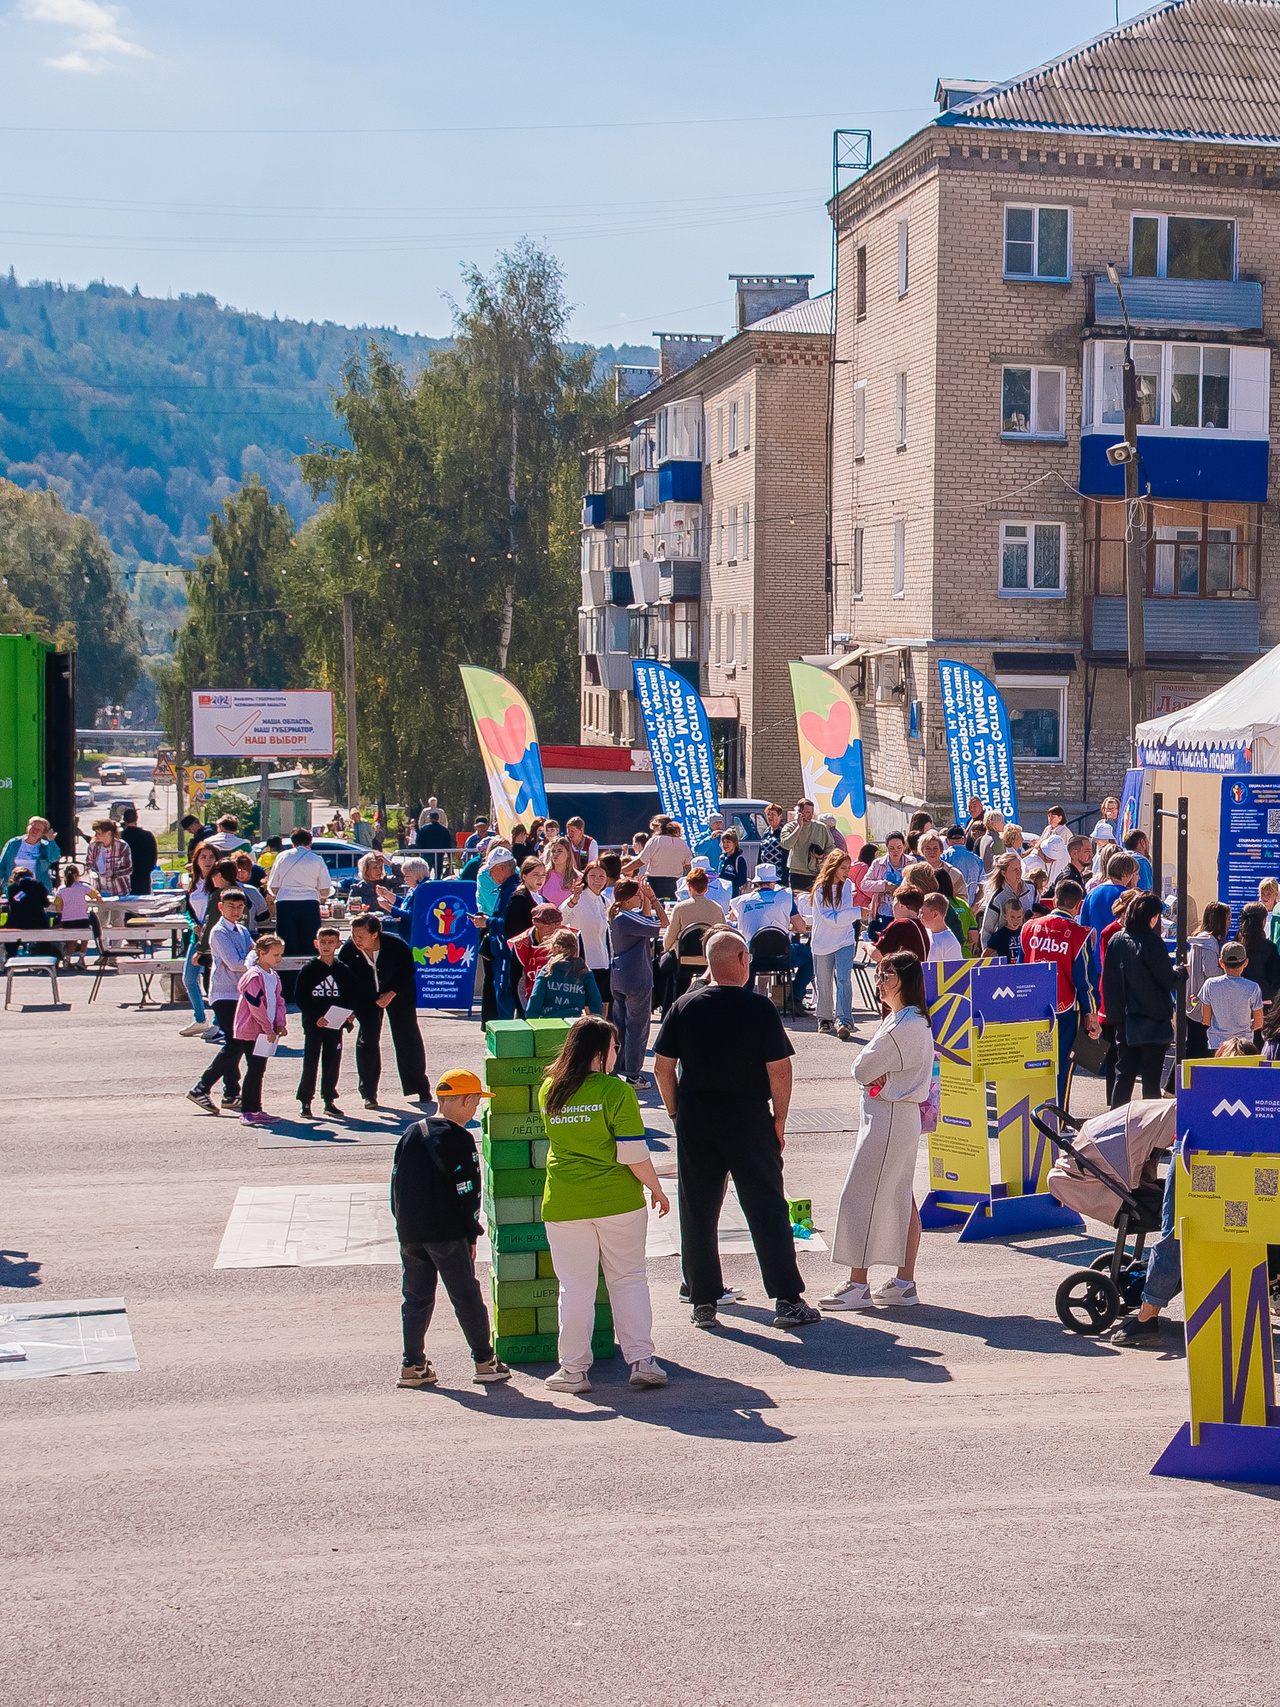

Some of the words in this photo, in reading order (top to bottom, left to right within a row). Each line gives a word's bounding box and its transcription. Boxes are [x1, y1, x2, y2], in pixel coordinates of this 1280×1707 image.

[245, 736, 266, 744] НАШ
[270, 736, 306, 744] ВЫБОР!
[1176, 751, 1208, 768] ПОМОГАТЬ
[1209, 753, 1235, 772] ЛЮДЯМ
[512, 1066, 542, 1075] МЕДИ
[550, 1115, 590, 1124] область
[504, 1234, 524, 1244] ПИК
[526, 1233, 546, 1243] ВОЗ
